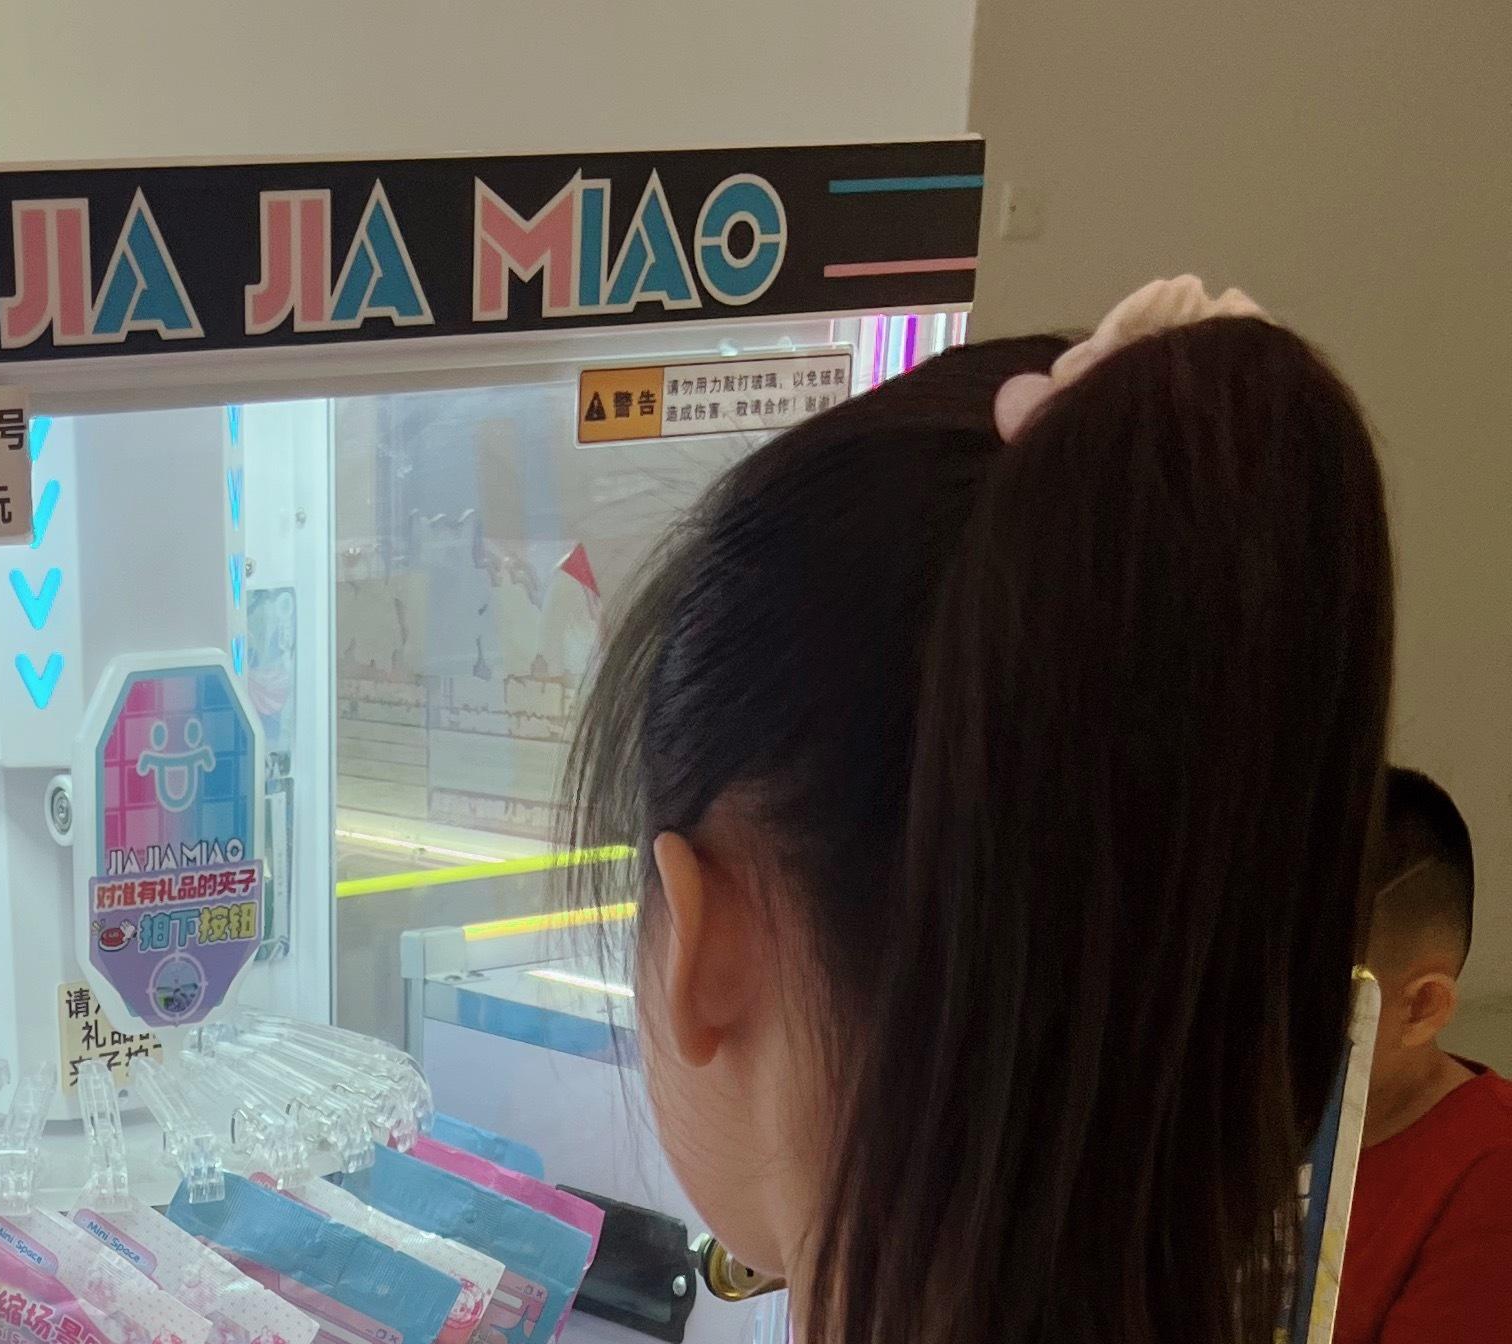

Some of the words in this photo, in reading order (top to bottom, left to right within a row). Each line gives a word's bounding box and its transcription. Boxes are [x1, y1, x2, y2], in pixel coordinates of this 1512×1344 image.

[0, 186, 205, 349] JIA
[244, 177, 435, 335] JIA
[473, 167, 789, 322] MIAO
[613, 390, 656, 418] 警告
[180, 837, 245, 866] MIAO
[95, 867, 257, 910] 对准有礼品的夹子
[139, 901, 257, 951] 拍下按钮
[16, 1238, 44, 1265] Space
[88, 1220, 109, 1242] Mini
[110, 1237, 141, 1264] Space
